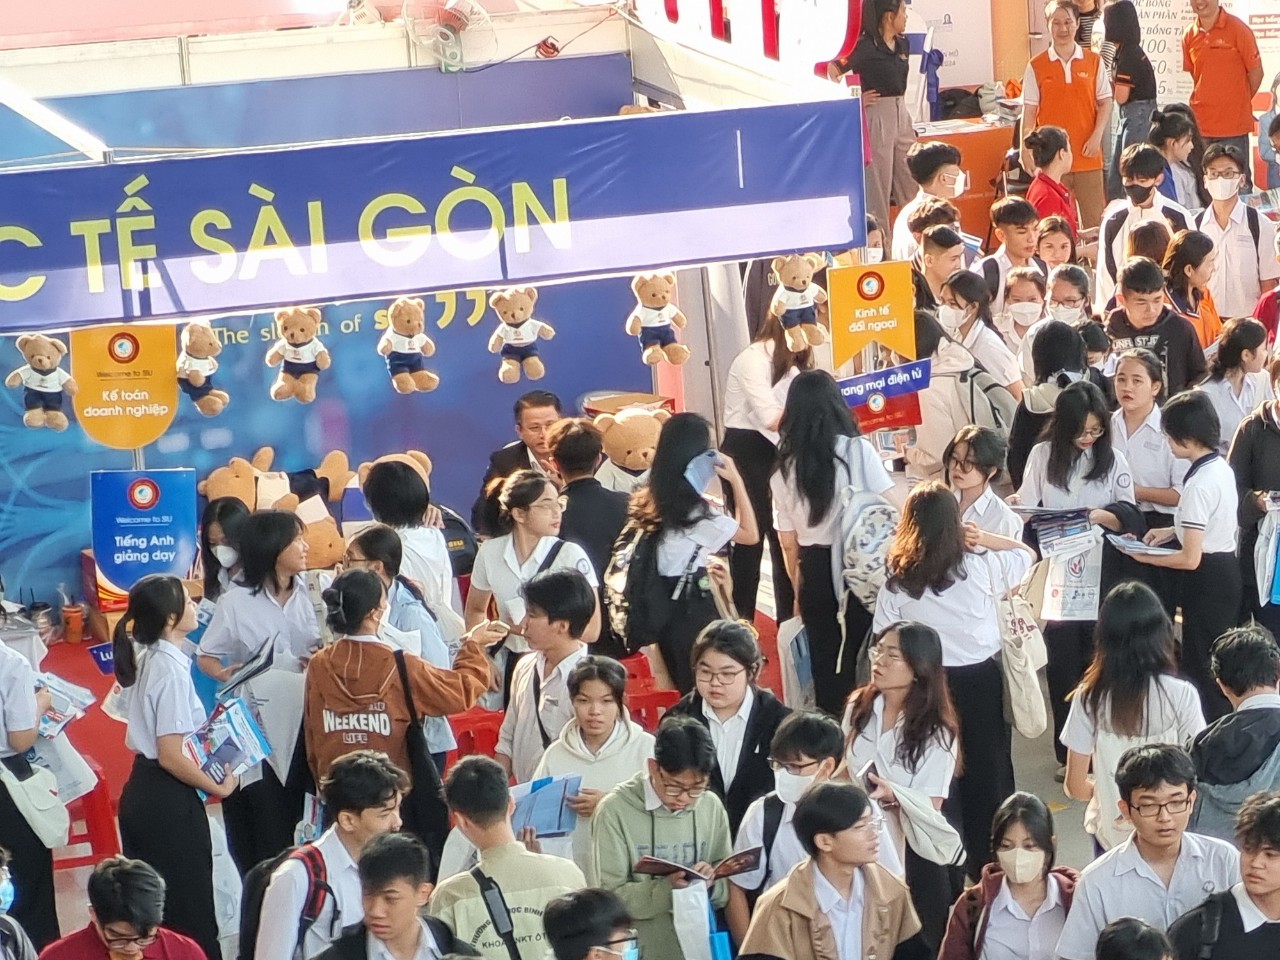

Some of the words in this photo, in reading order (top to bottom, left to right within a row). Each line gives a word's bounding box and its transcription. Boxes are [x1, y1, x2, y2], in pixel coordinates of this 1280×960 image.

[70, 174, 163, 293] TẾ
[190, 183, 329, 284] SÀI
[358, 166, 572, 267] GÒN
[855, 307, 877, 319] Kinh
[879, 304, 891, 316] tế
[340, 314, 361, 336] of
[868, 319, 898, 333] ngoại
[865, 377, 886, 390] mại
[887, 371, 911, 385] điện
[102, 388, 119, 401] Kế
[121, 389, 149, 401] toán
[83, 405, 123, 417] doanh
[125, 404, 168, 418] nghiệp
[114, 534, 148, 549] Tiếng
[150, 535, 175, 547] Anh
[114, 549, 149, 565] giảng
[152, 550, 176, 563] dạy
[323, 709, 391, 736] WEEKEND
